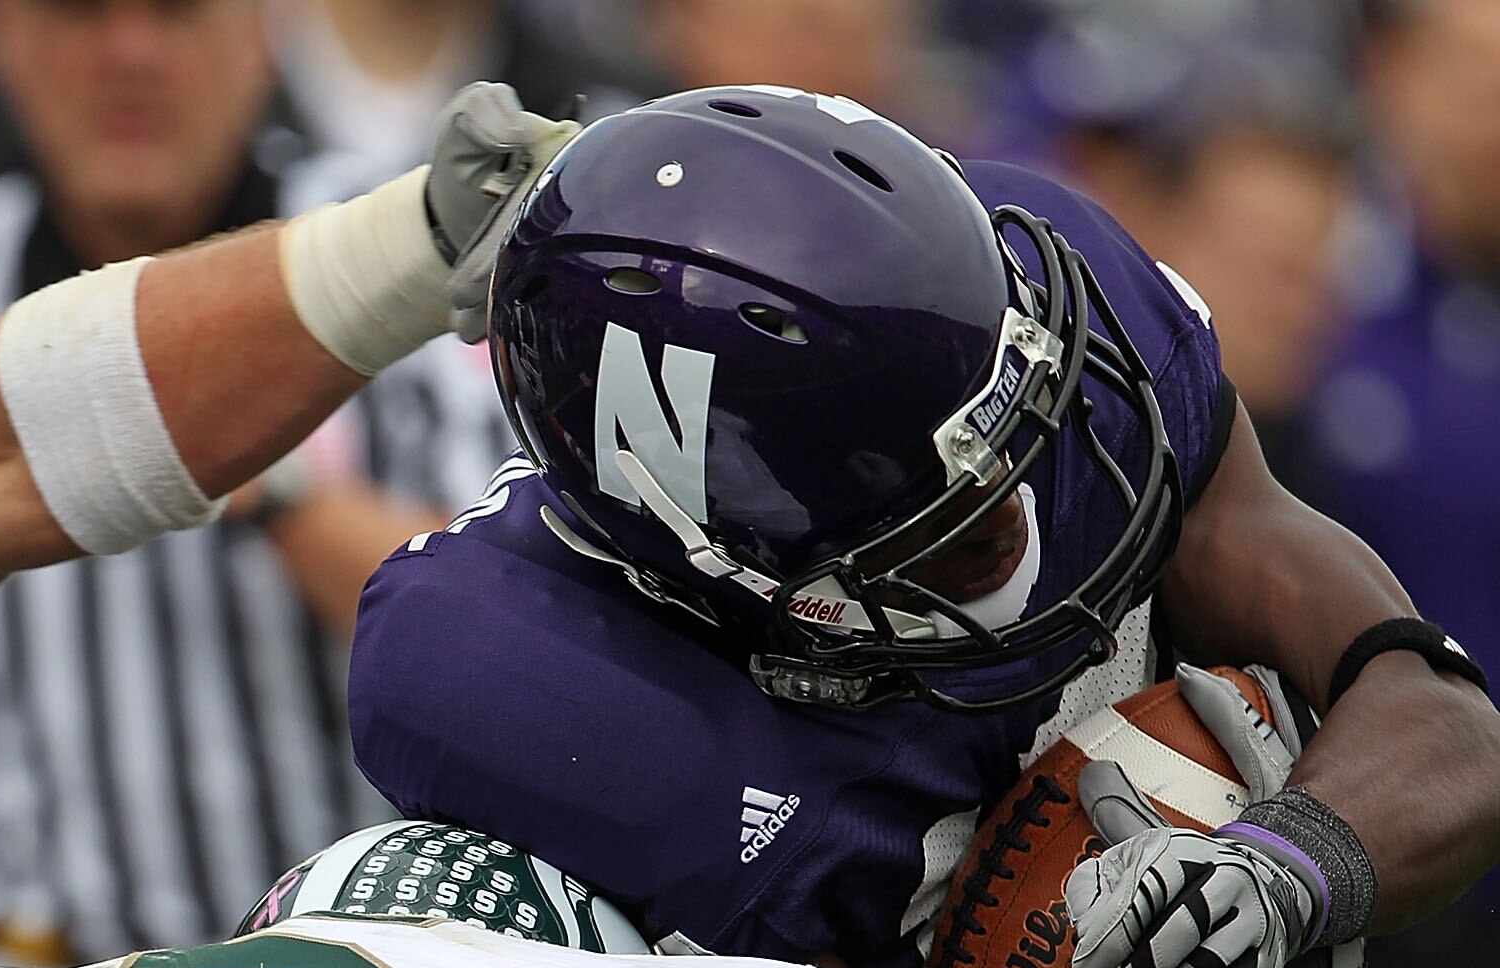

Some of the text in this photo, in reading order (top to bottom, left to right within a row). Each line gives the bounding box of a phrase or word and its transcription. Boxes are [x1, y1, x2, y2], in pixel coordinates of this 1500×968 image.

[972, 361, 1020, 434] BIG TEN
[595, 321, 716, 525] N
[403, 827, 432, 838] S
[444, 831, 470, 843] S
[741, 795, 801, 864] adidas
[383, 838, 410, 851] S
[421, 840, 447, 855] S
[464, 846, 489, 862] S
[488, 841, 512, 855] S
[364, 855, 390, 873] S
[410, 857, 435, 876] S
[450, 861, 476, 881] S
[352, 877, 378, 900] S
[395, 878, 420, 901] S
[490, 870, 515, 892] S
[436, 881, 460, 905] S
[473, 889, 498, 914] S
[515, 902, 538, 929] S
